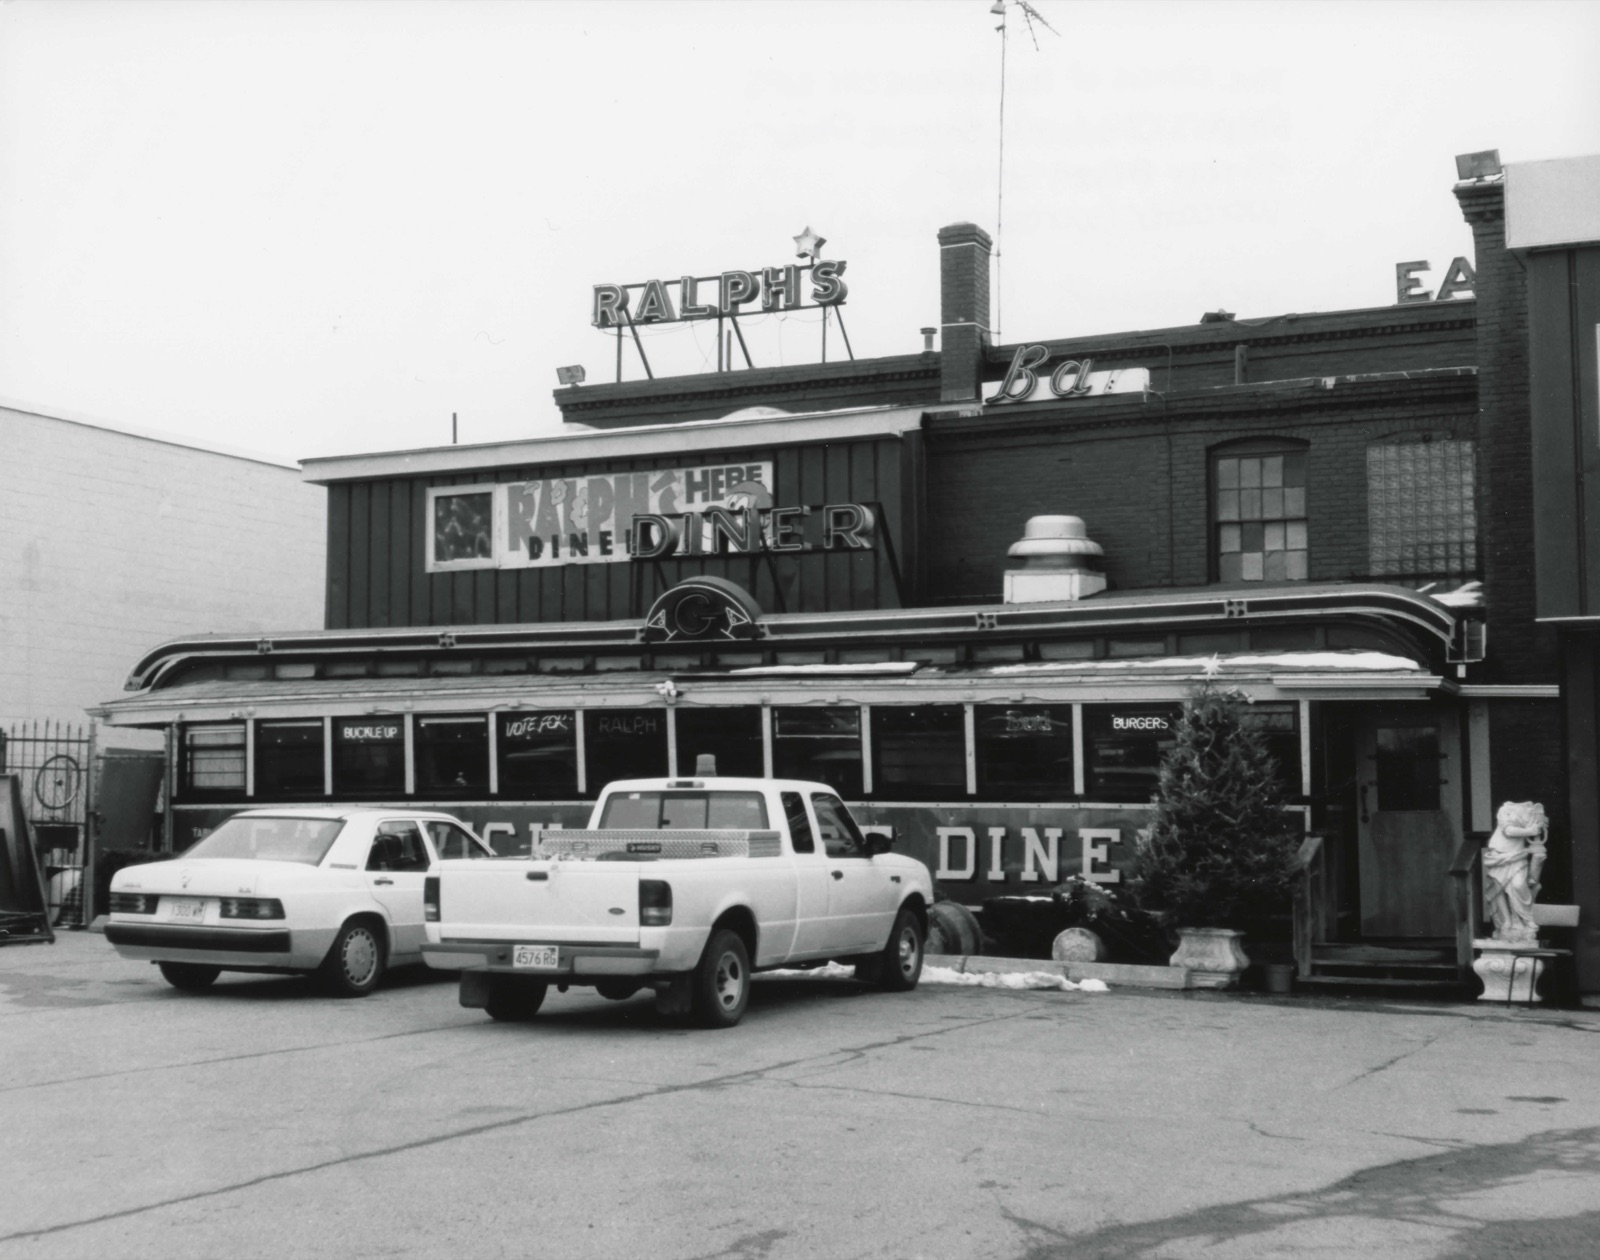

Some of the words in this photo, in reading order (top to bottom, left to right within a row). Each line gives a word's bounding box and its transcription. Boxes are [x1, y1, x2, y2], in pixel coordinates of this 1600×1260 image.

[631, 503, 876, 560] DINER
[506, 717, 538, 737] VOTE
[600, 716, 656, 733] RALPH
[1112, 717, 1169, 729] BURGERS
[343, 727, 382, 739] BUCKLE
[383, 727, 398, 739] UP
[936, 826, 1149, 883] DINE
[515, 952, 542, 965] 4576
